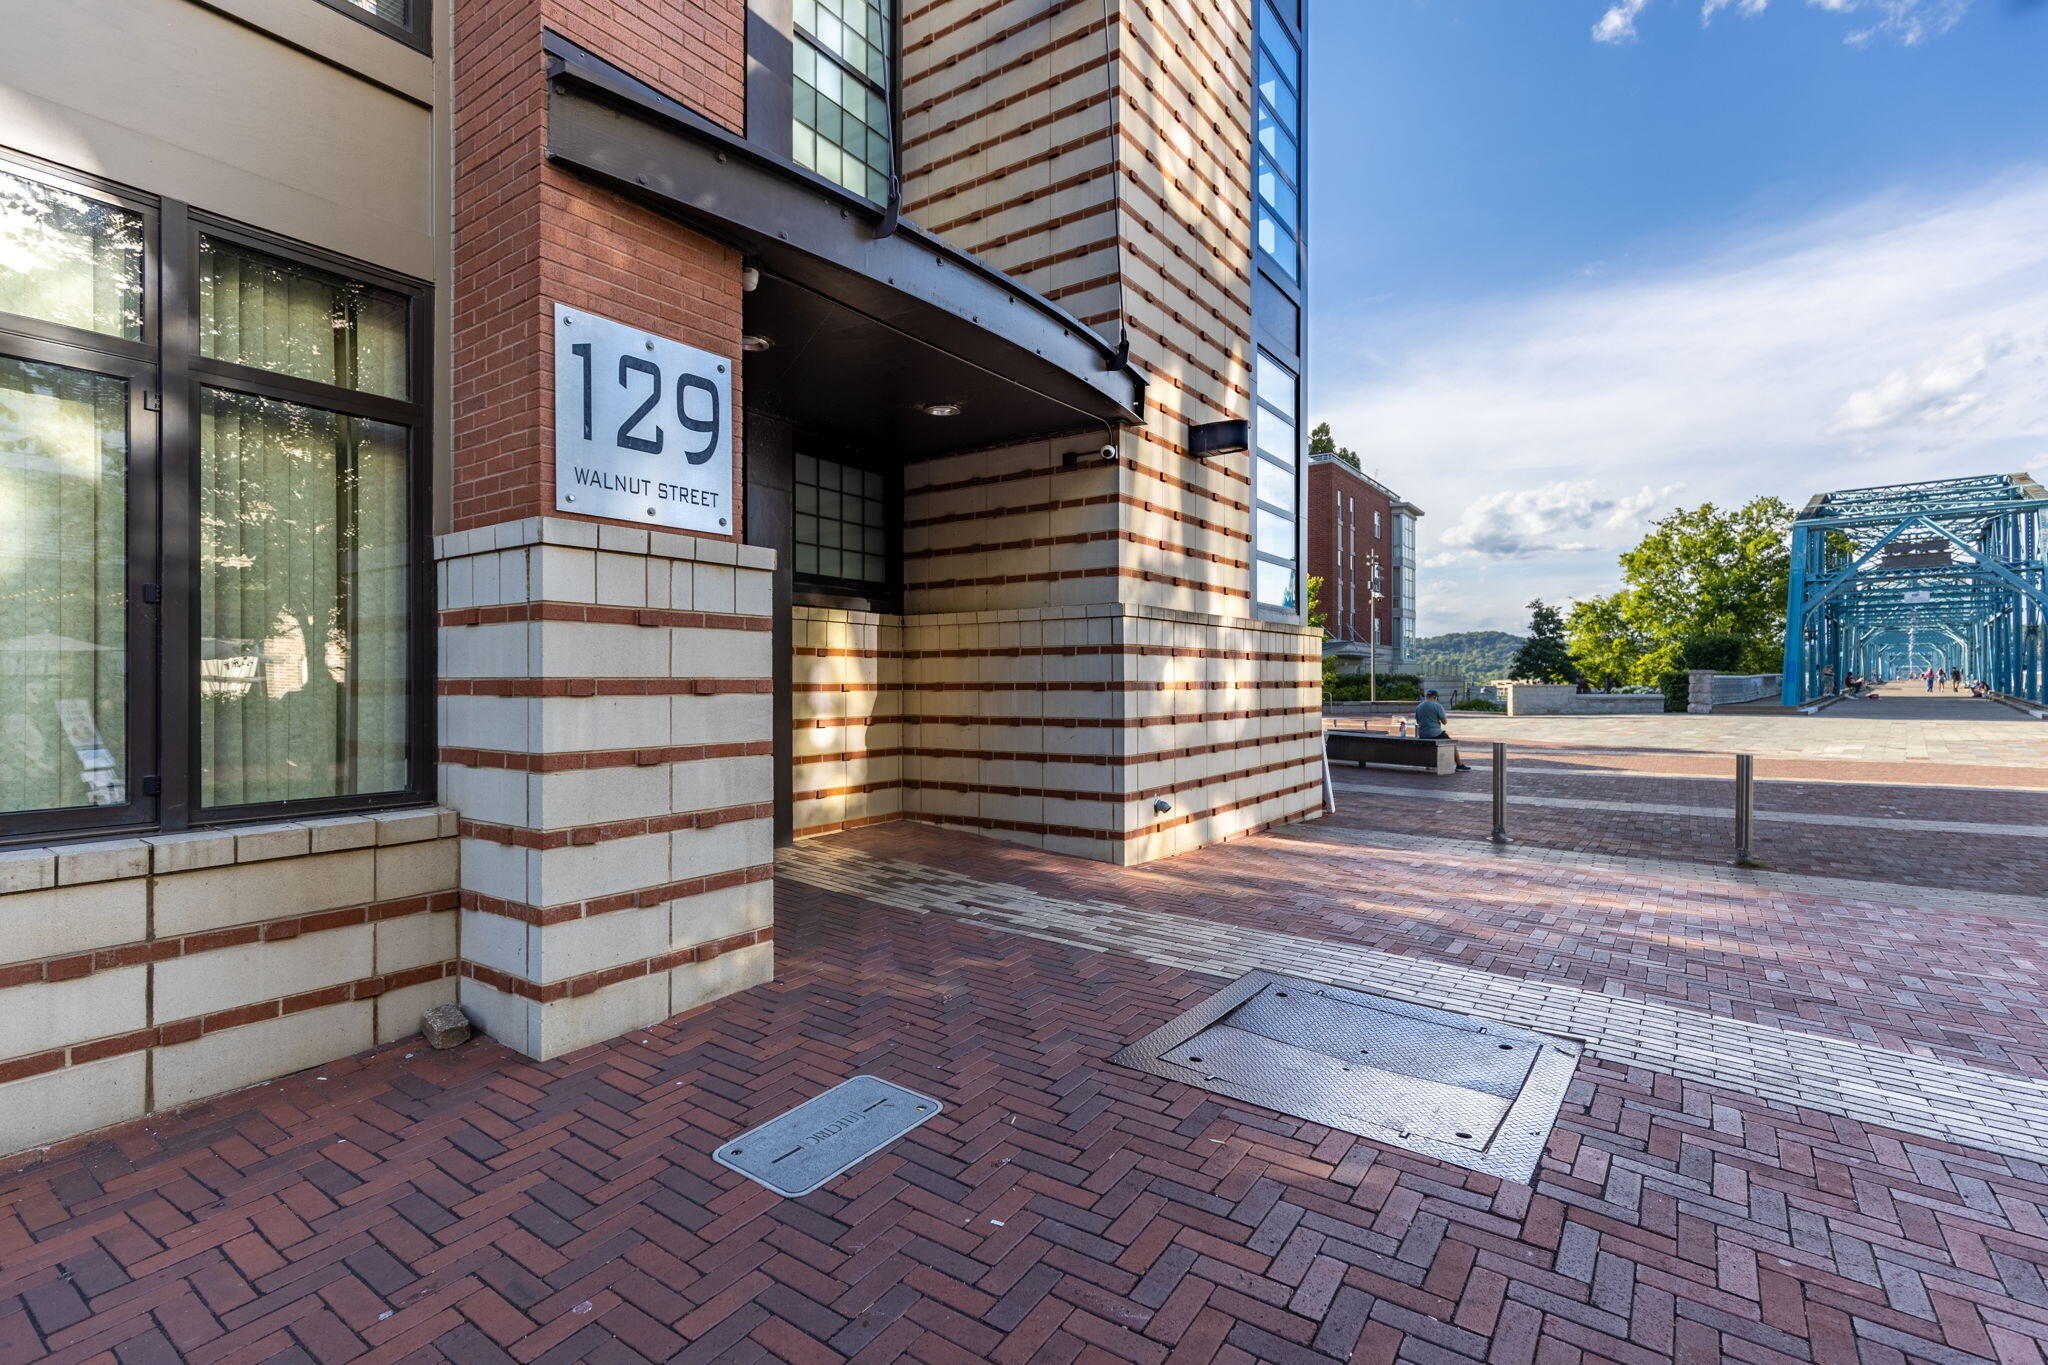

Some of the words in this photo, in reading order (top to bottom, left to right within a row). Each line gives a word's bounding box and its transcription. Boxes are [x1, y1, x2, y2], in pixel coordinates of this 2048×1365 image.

[572, 343, 719, 465] 129
[574, 466, 651, 496] WALNUT
[658, 482, 719, 508] STREET
[805, 1113, 860, 1144] ELECTRIC
